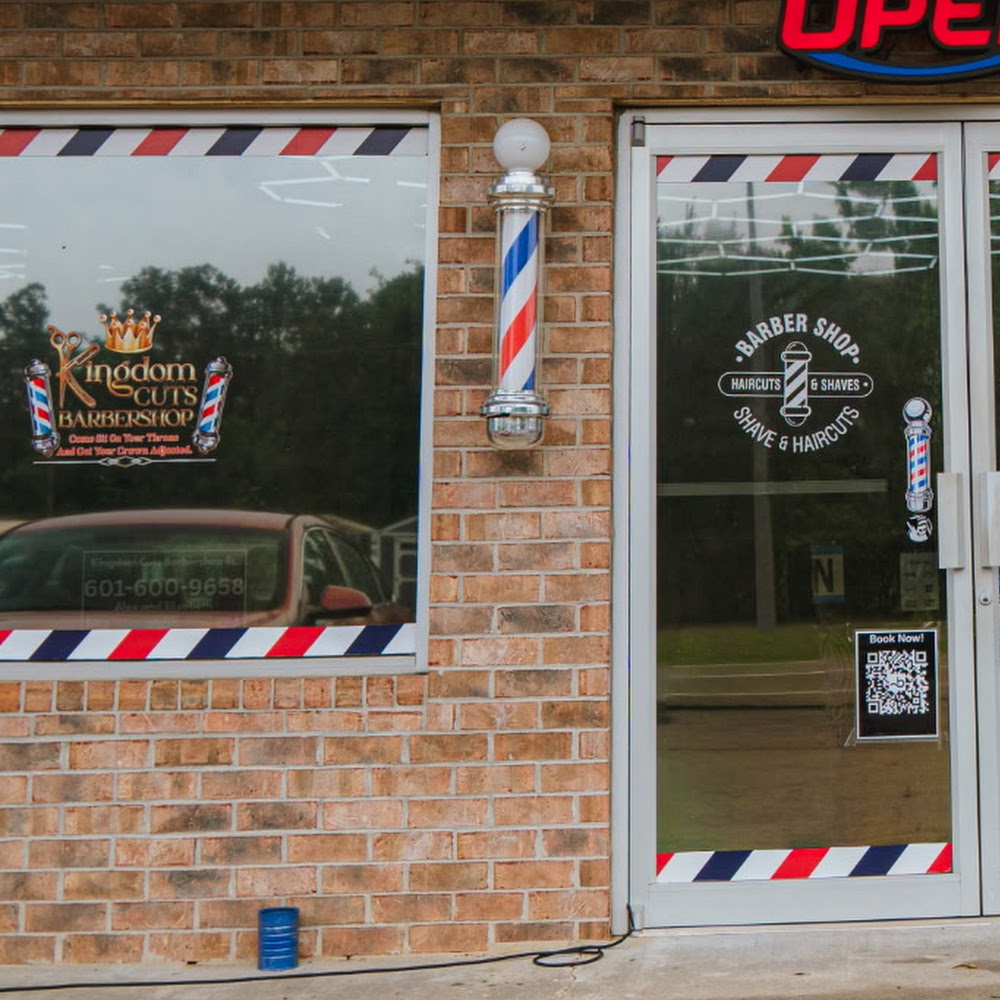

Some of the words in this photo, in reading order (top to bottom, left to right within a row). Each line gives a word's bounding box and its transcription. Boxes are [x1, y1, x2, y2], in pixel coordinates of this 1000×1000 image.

[735, 313, 808, 357] BARBER
[813, 317, 860, 361] SHOP
[46, 325, 198, 408] Kingdom
[731, 377, 782, 391] HAIRCUTS
[811, 378, 818, 391] &
[821, 378, 860, 391] SHAVES
[133, 385, 199, 406] CUTS
[57, 408, 194, 429] BARBERSHOP
[733, 406, 778, 448] SHAVE
[778, 435, 789, 451] &
[793, 405, 860, 453] HAIRCUTS
[84, 577, 244, 598] 601-600-9658
[869, 633, 895, 644] Book
[898, 633, 924, 644] Now!
